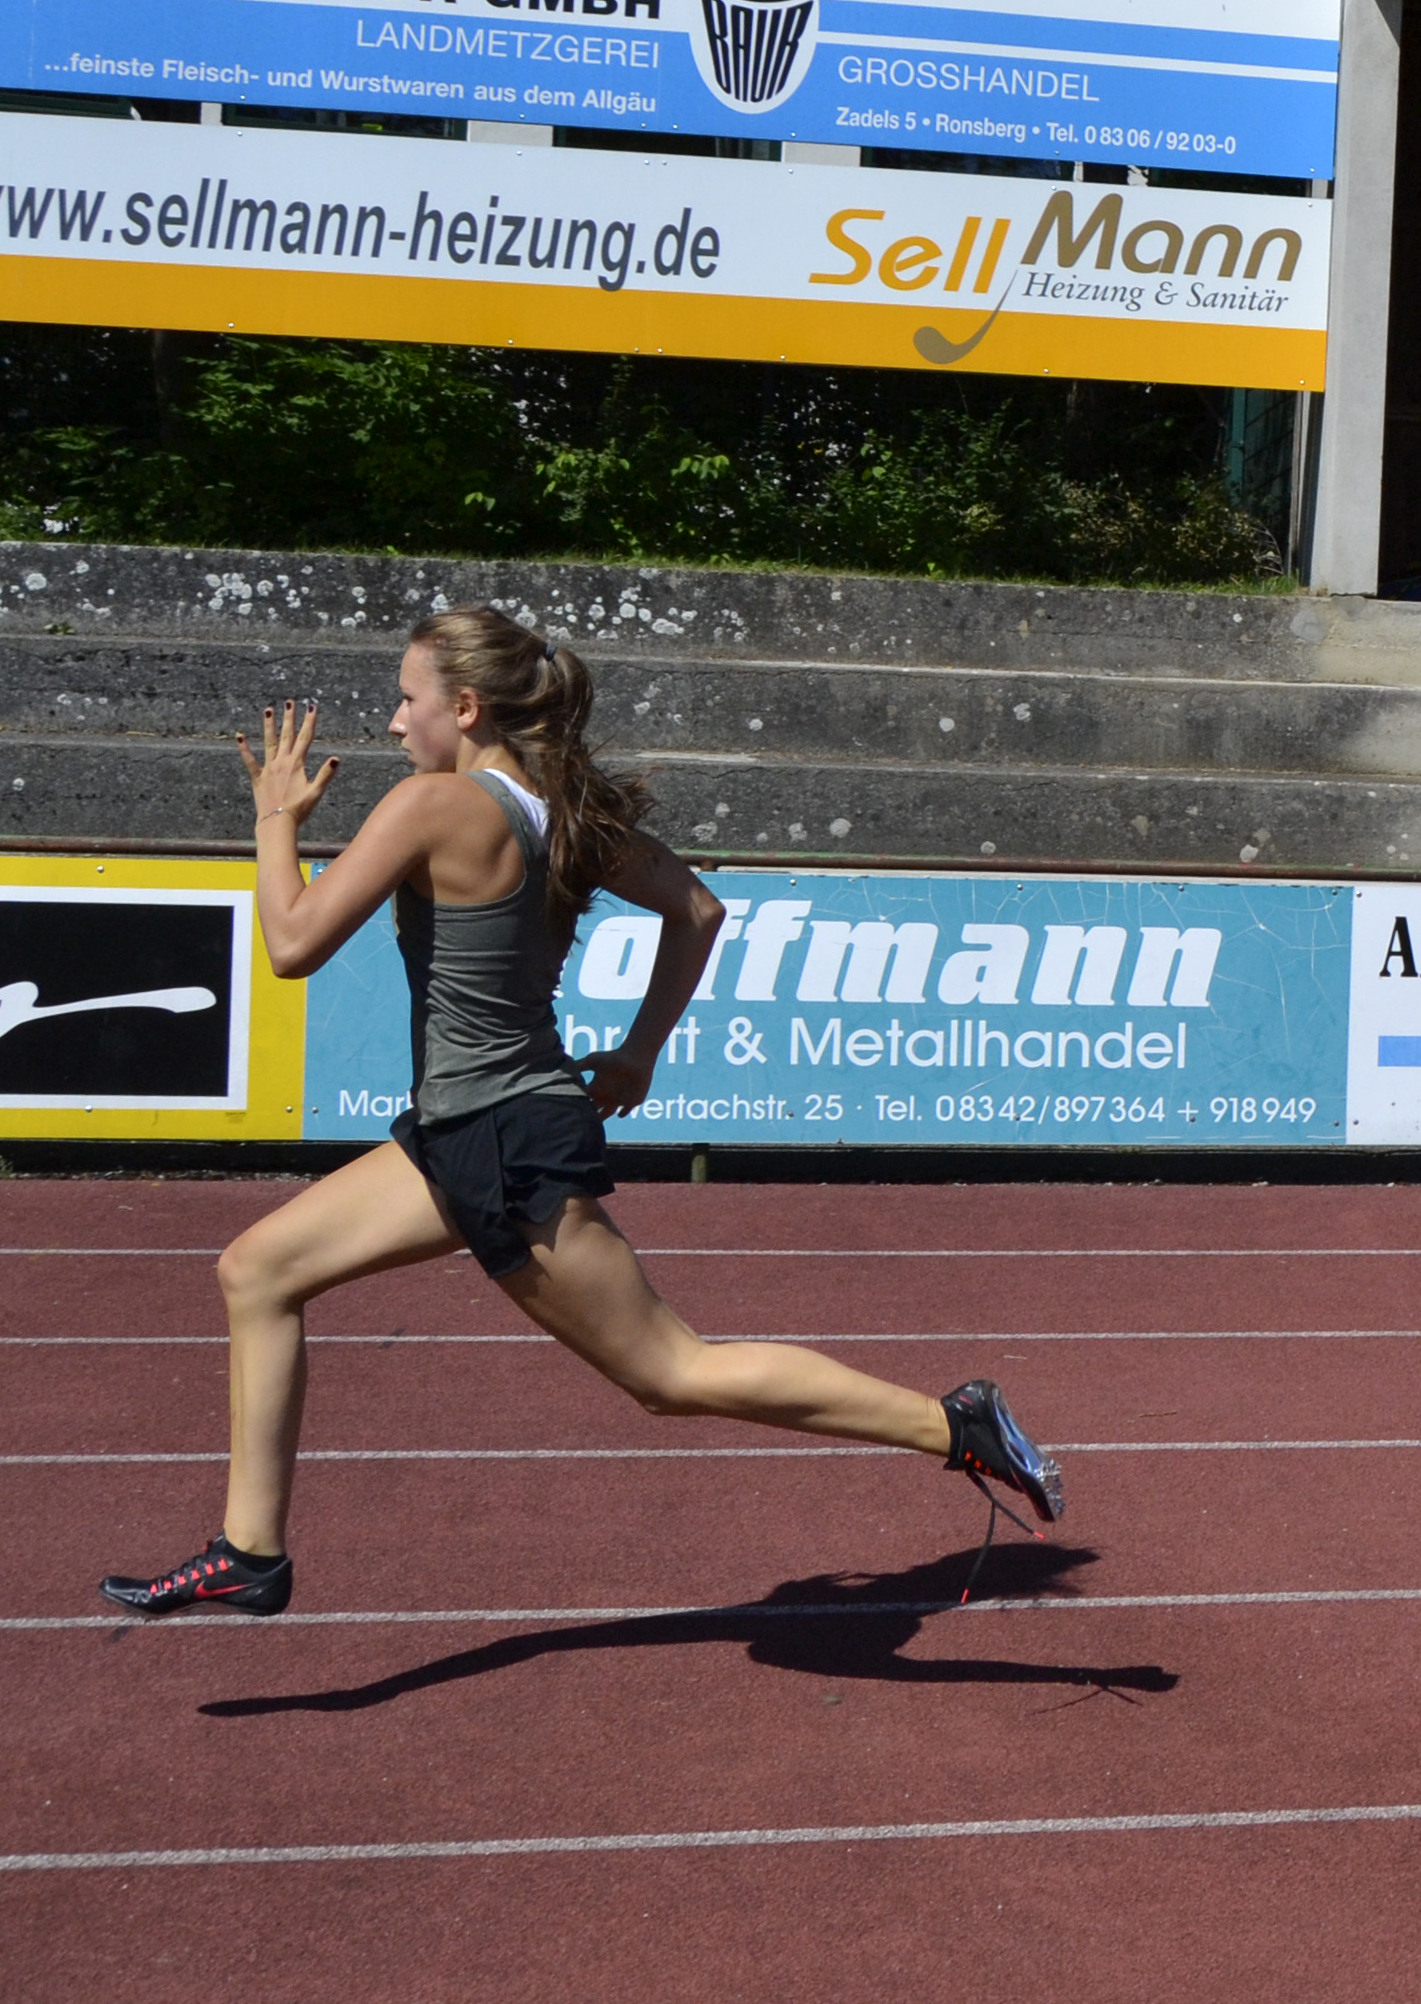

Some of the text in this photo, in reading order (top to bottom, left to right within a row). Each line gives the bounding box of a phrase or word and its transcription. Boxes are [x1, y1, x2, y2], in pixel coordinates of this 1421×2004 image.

[356, 19, 660, 69] LANDMETZGEREI
[701, 0, 814, 103] BAUR
[162, 59, 259, 85] Fleisch-
[267, 69, 313, 89] und
[320, 69, 465, 99] Wurstwaren
[473, 84, 517, 103] aus
[523, 85, 576, 107] dem
[581, 88, 657, 115] Allgäu
[837, 55, 1099, 102] GROSSHANDEL
[836, 106, 900, 130] Zadels
[904, 111, 917, 131] 5
[935, 113, 1026, 143] Ronsberg
[1046, 122, 1079, 143] Tel.
[0, 177, 721, 293] ww.sellmann-heizung.de
[1022, 272, 1290, 313] Heizung & Sanitär
[723, 1016, 768, 1066] &
[790, 1017, 1187, 1069] Metallhandel
[597, 1093, 790, 1120] ertachstr.
[804, 1093, 844, 1121] 25
[875, 1094, 923, 1121] Tel.
[1177, 1100, 1199, 1122] +
